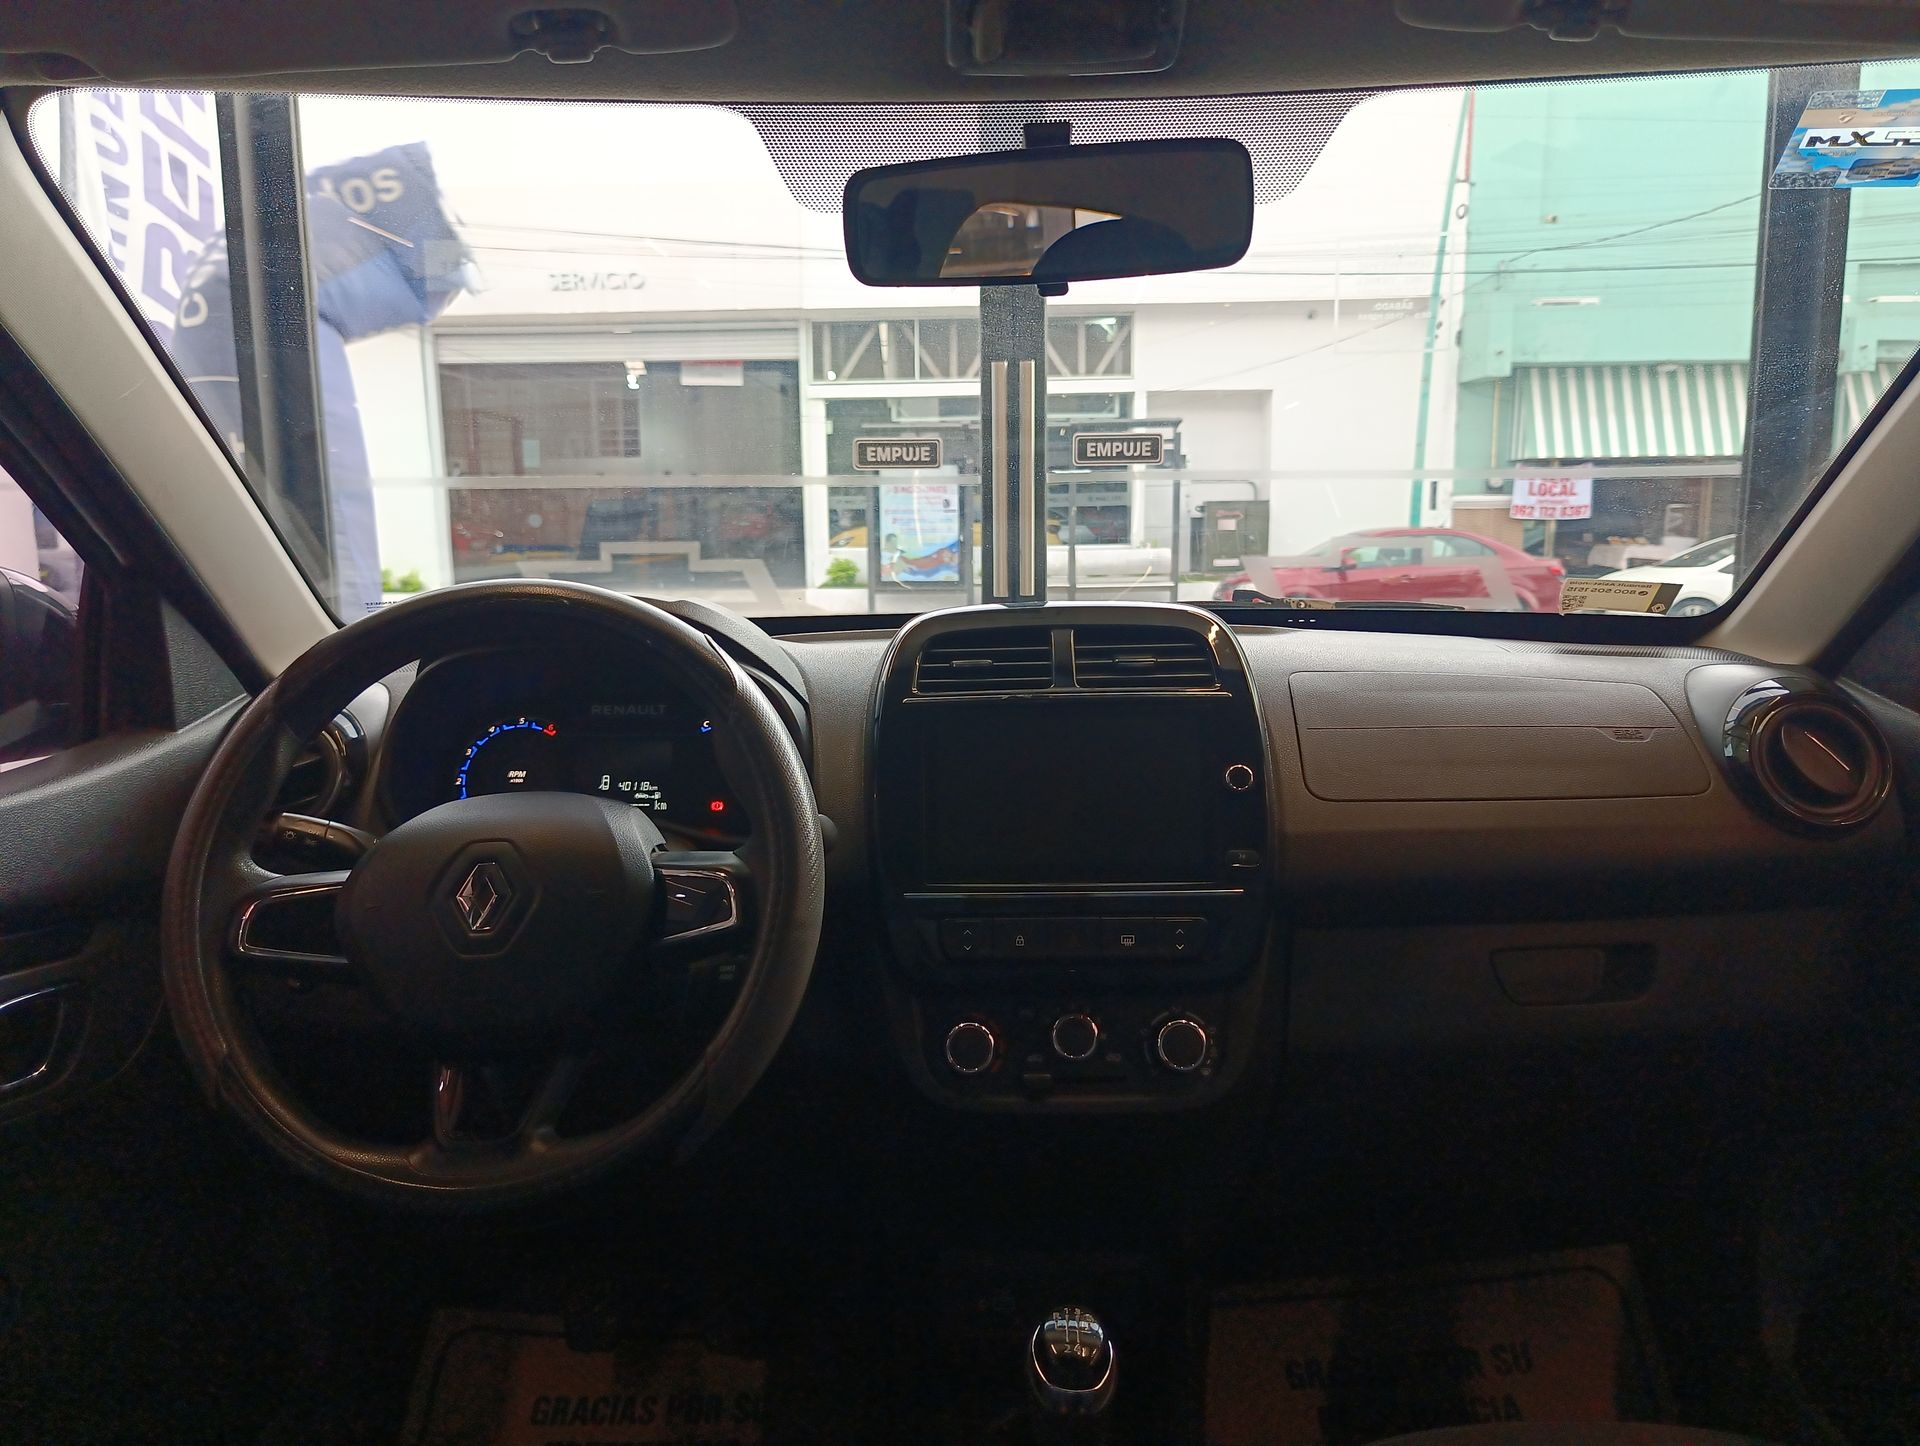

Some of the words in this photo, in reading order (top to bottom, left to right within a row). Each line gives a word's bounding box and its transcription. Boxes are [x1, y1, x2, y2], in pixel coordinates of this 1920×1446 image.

[1086, 440, 1152, 458] EMPUJE
[866, 446, 931, 462] EMPUJE
[1527, 481, 1578, 496] LOCAL
[591, 704, 668, 715] RENAULT
[518, 717, 525, 725] 5
[547, 723, 555, 731] 6
[465, 748, 472, 756] 3
[507, 770, 527, 778] RPM
[454, 778, 463, 786] 2
[654, 801, 667, 811] km
[1064, 1344, 1071, 1353] 2
[530, 1395, 658, 1426] GRACIAS
